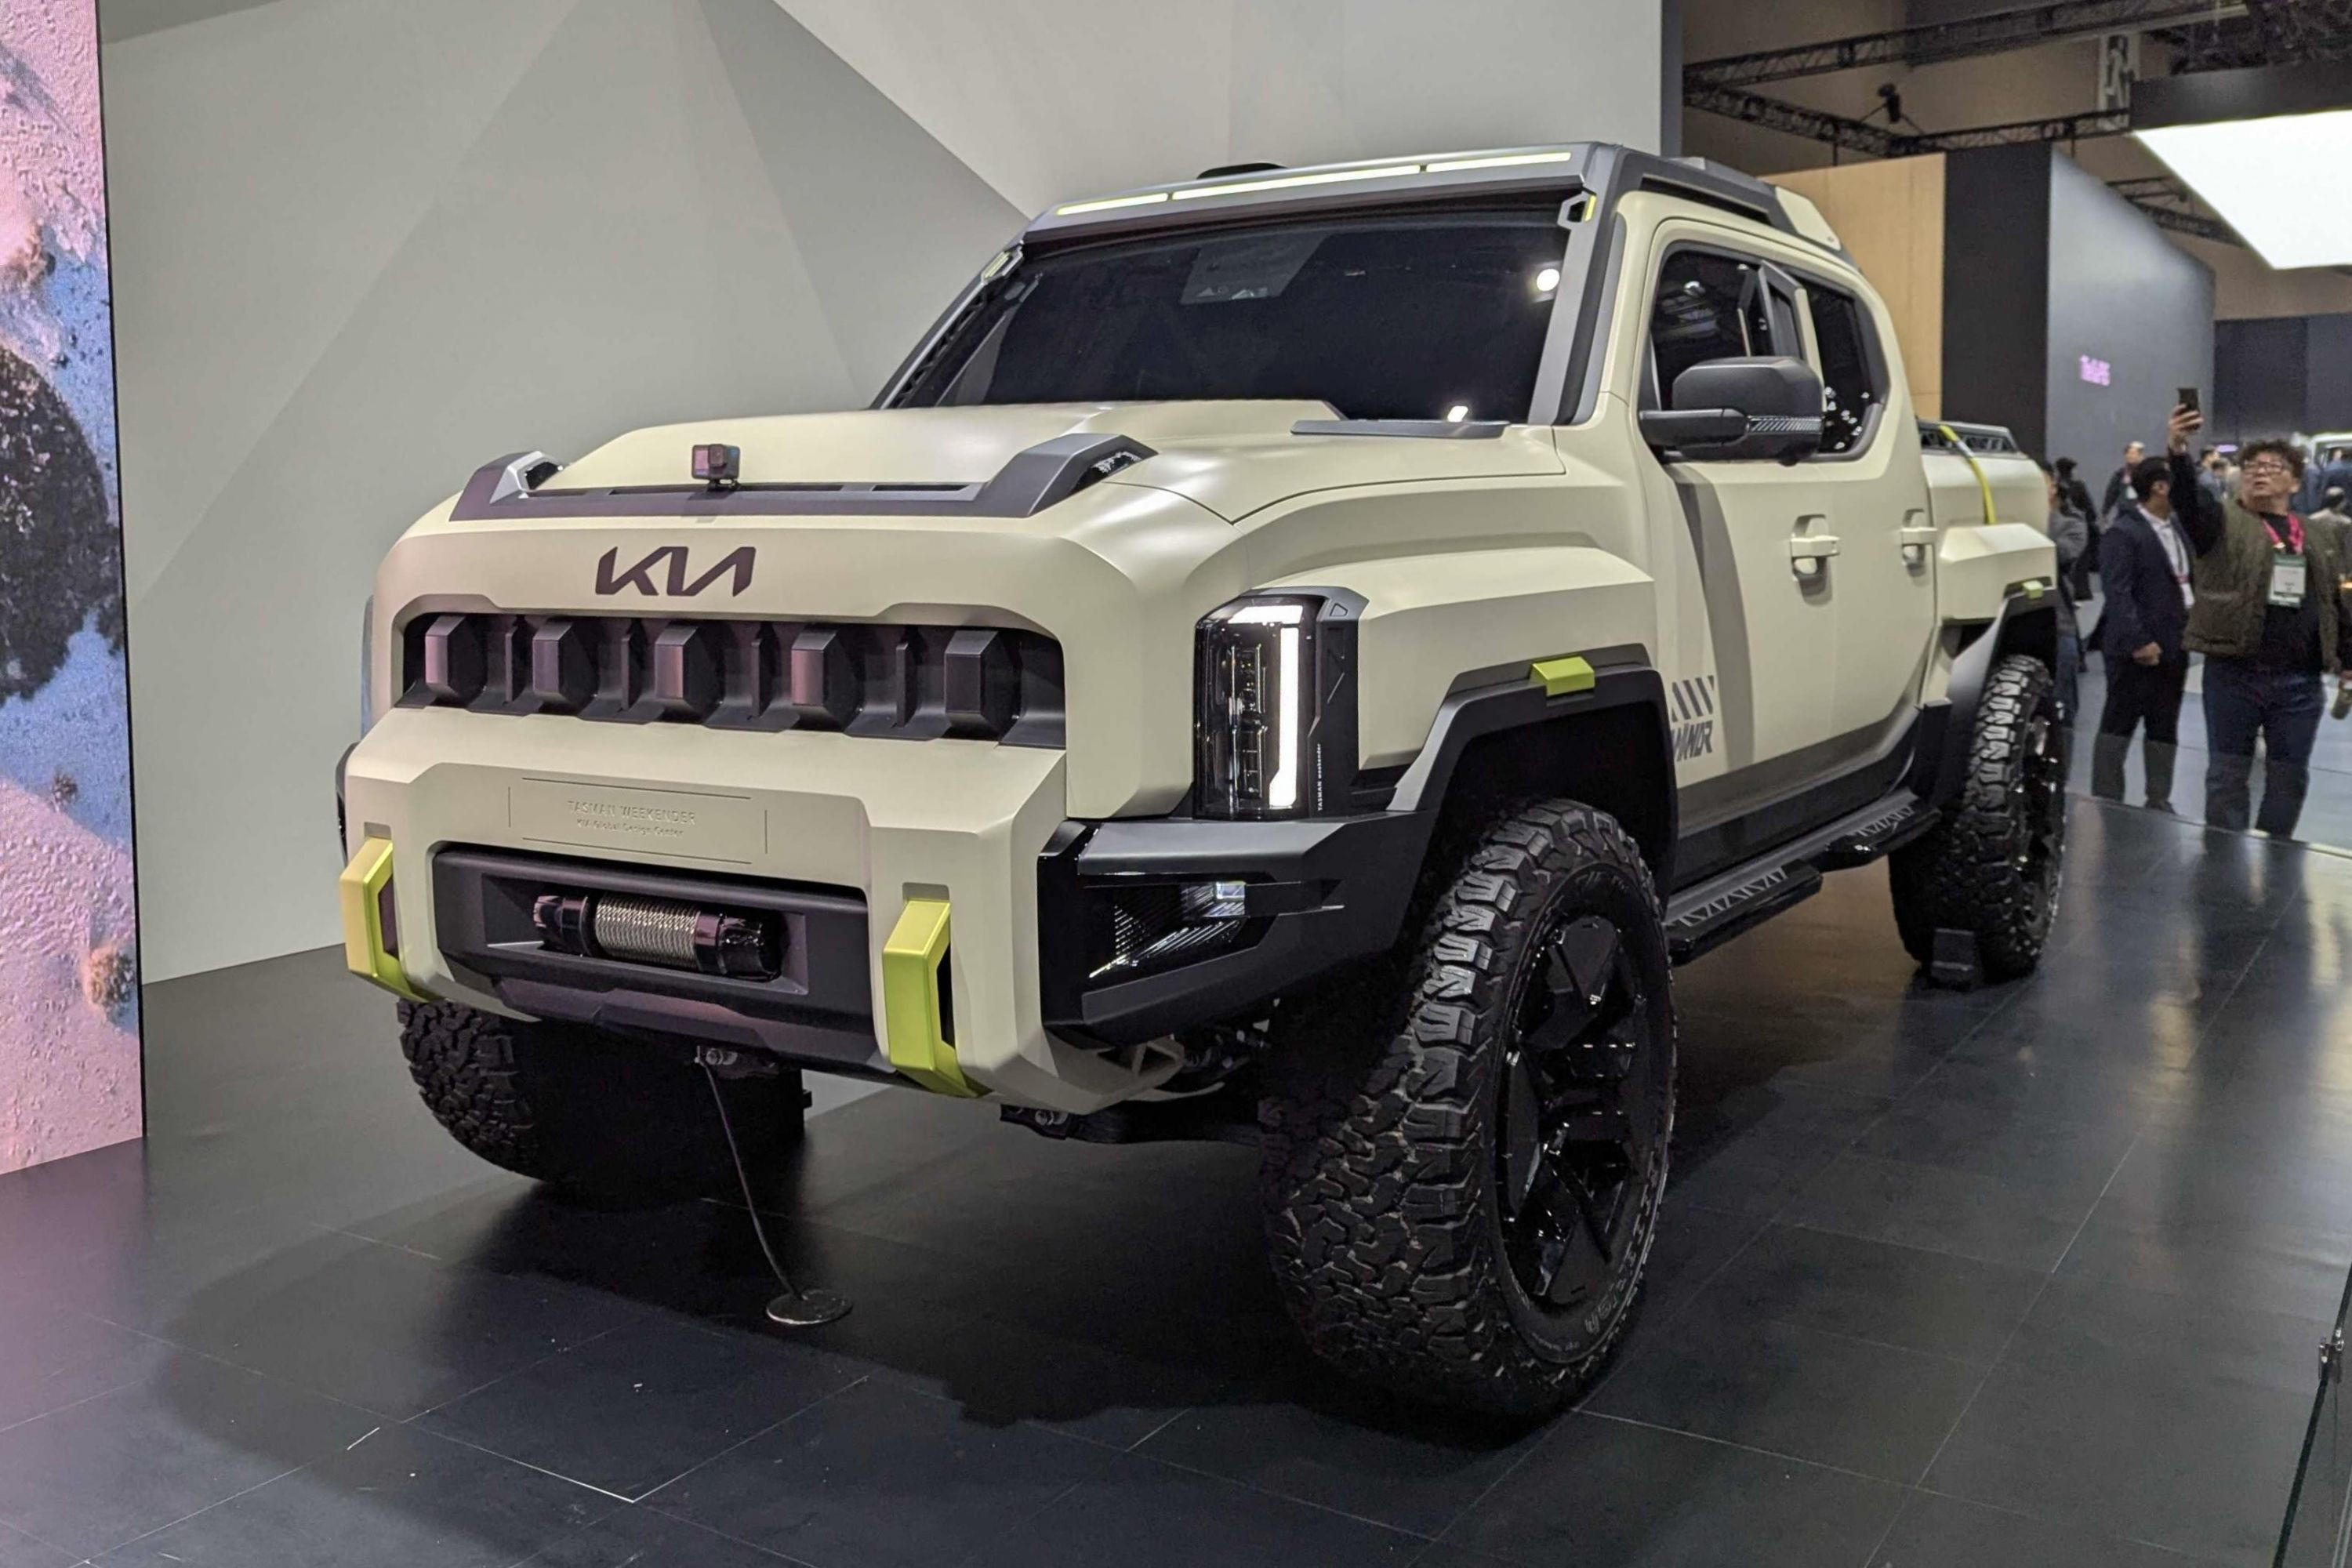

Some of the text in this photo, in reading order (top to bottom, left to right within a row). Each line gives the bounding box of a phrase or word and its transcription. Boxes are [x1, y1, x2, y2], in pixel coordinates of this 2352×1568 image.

[595, 546, 757, 597] KIA
[567, 800, 696, 825] TASMAN WEEKENDER
